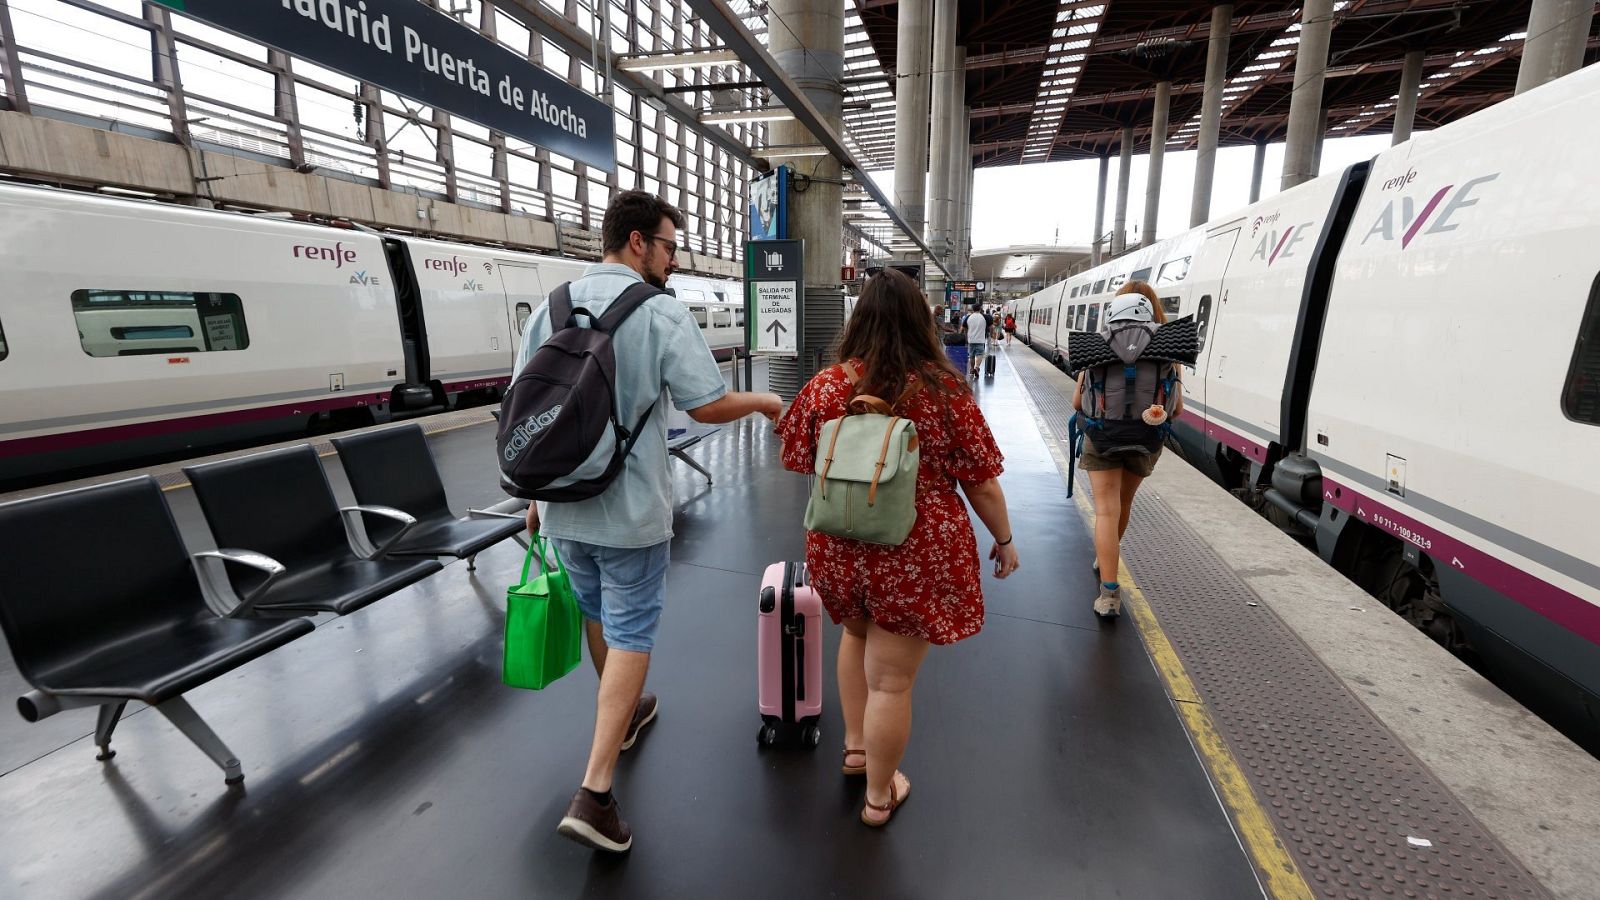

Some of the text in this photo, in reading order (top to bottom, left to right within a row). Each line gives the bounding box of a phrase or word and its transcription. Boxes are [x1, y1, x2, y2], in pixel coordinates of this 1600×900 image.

[282, 0, 587, 139] adrid Puerta de Atocha
[1381, 165, 1418, 192] renfe
[1360, 171, 1502, 251] AVE
[293, 241, 357, 269] renfe
[1249, 221, 1315, 267] AVE
[349, 270, 380, 287] AVE
[424, 255, 468, 278] renfe
[463, 279, 484, 292] AVE
[504, 404, 563, 461] adidas
